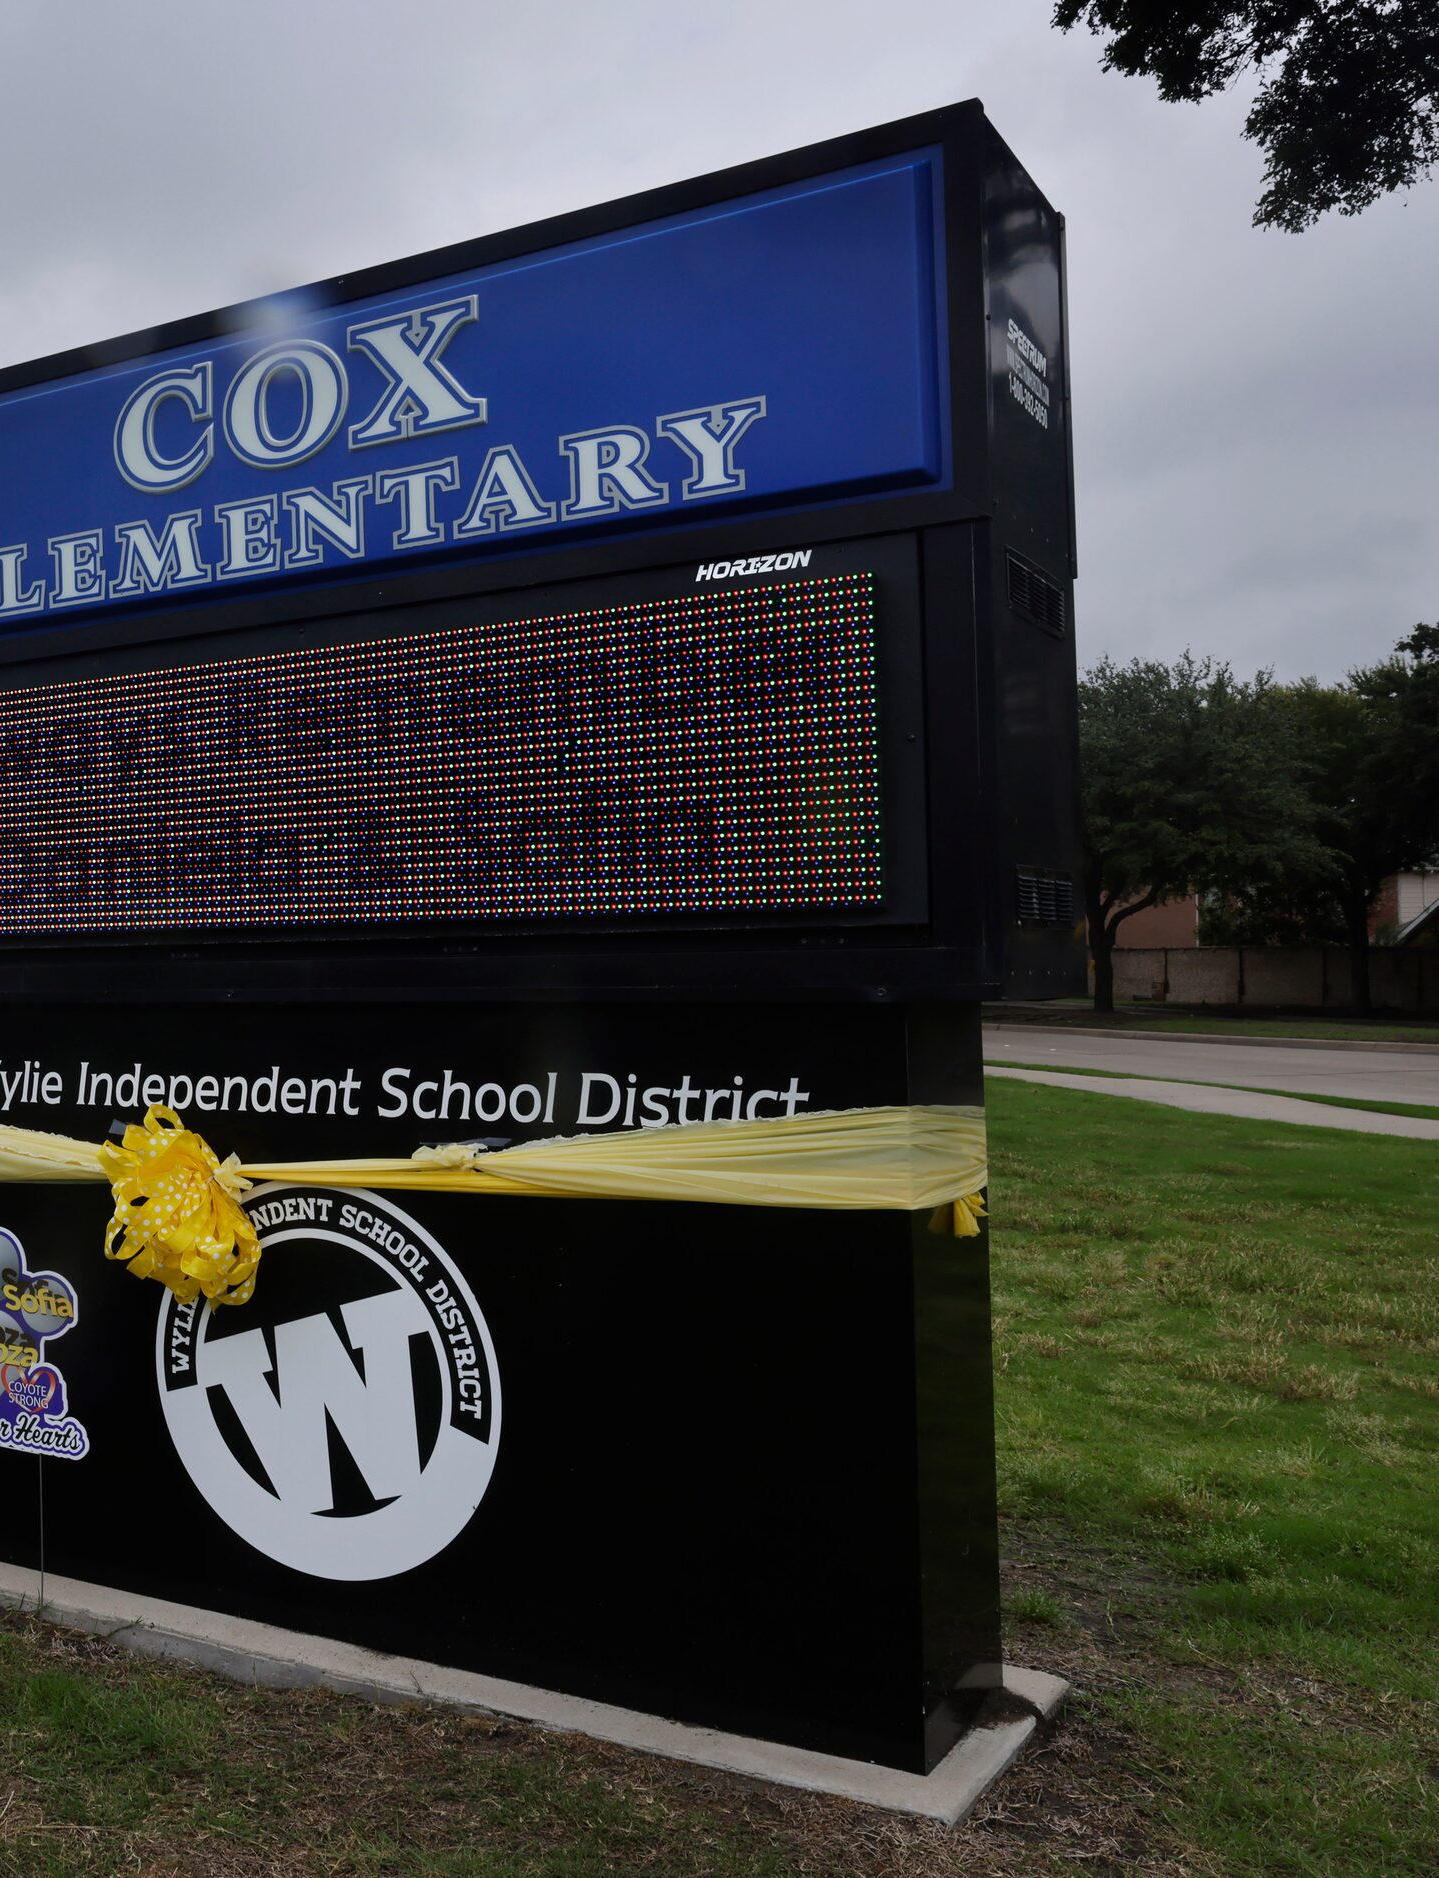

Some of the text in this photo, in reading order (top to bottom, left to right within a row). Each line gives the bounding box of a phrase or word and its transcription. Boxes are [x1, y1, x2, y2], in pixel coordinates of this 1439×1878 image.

[1007, 318, 1047, 377] SPECTRUM
[114, 294, 487, 494] COX
[695, 550, 812, 582] HORIZON
[454, 783, 716, 882] Sofia
[76, 1061, 362, 1115] Independent
[377, 1067, 558, 1122] School
[575, 1072, 810, 1128] District
[3, 1284, 74, 1318] Sofia
[339, 1204, 483, 1420] SCHOOL DISTRICT
[8, 1381, 47, 1397] COYOTE
[8, 1392, 49, 1409] STRONG
[14, 1414, 81, 1451] Hearts
